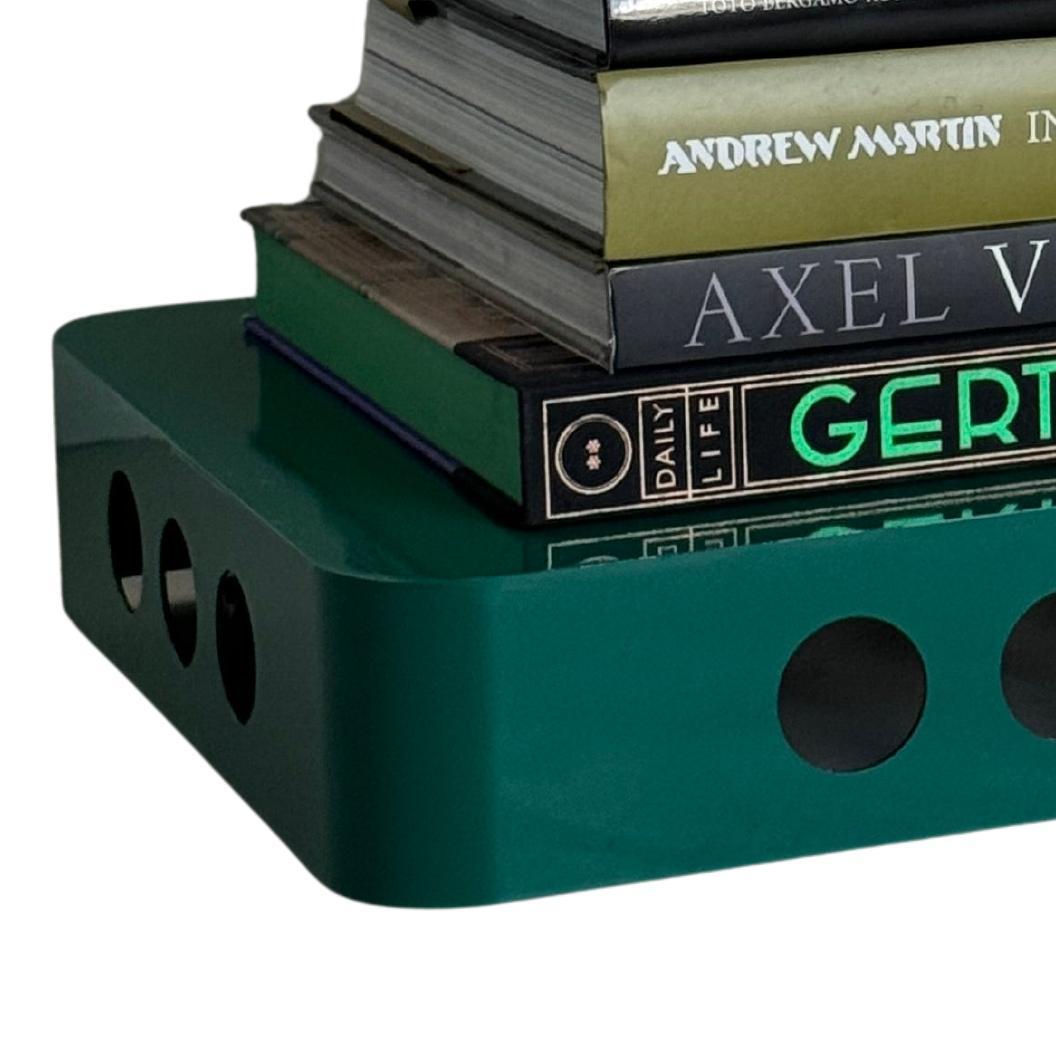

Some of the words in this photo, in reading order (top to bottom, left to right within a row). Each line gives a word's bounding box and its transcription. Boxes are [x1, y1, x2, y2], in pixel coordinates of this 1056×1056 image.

[656, 126, 842, 176] ANDREW
[847, 112, 1004, 161] MARTIN
[683, 252, 952, 349] AXEL
[653, 402, 679, 491] DAILY
[698, 393, 723, 486] LIFE
